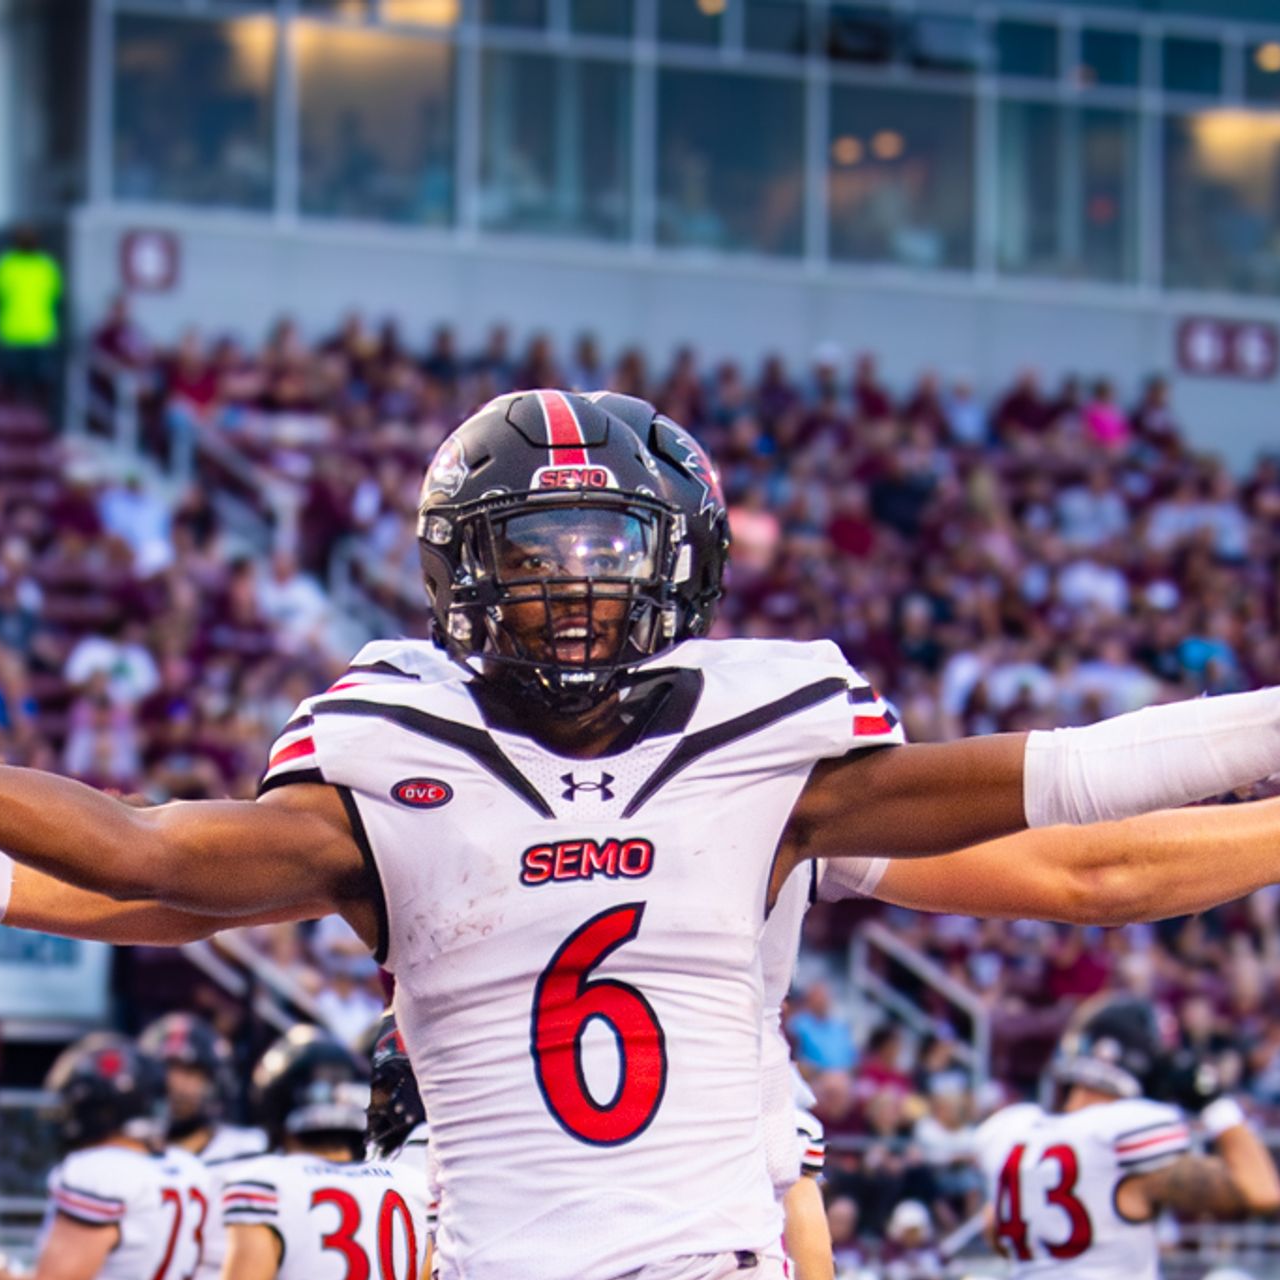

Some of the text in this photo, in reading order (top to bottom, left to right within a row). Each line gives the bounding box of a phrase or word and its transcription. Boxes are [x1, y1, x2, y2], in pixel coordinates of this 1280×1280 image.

[540, 468, 608, 490] SEMO
[405, 787, 437, 799] OVC
[519, 837, 656, 886] SEMO
[528, 900, 669, 1148] 6
[994, 1142, 1094, 1262] 43
